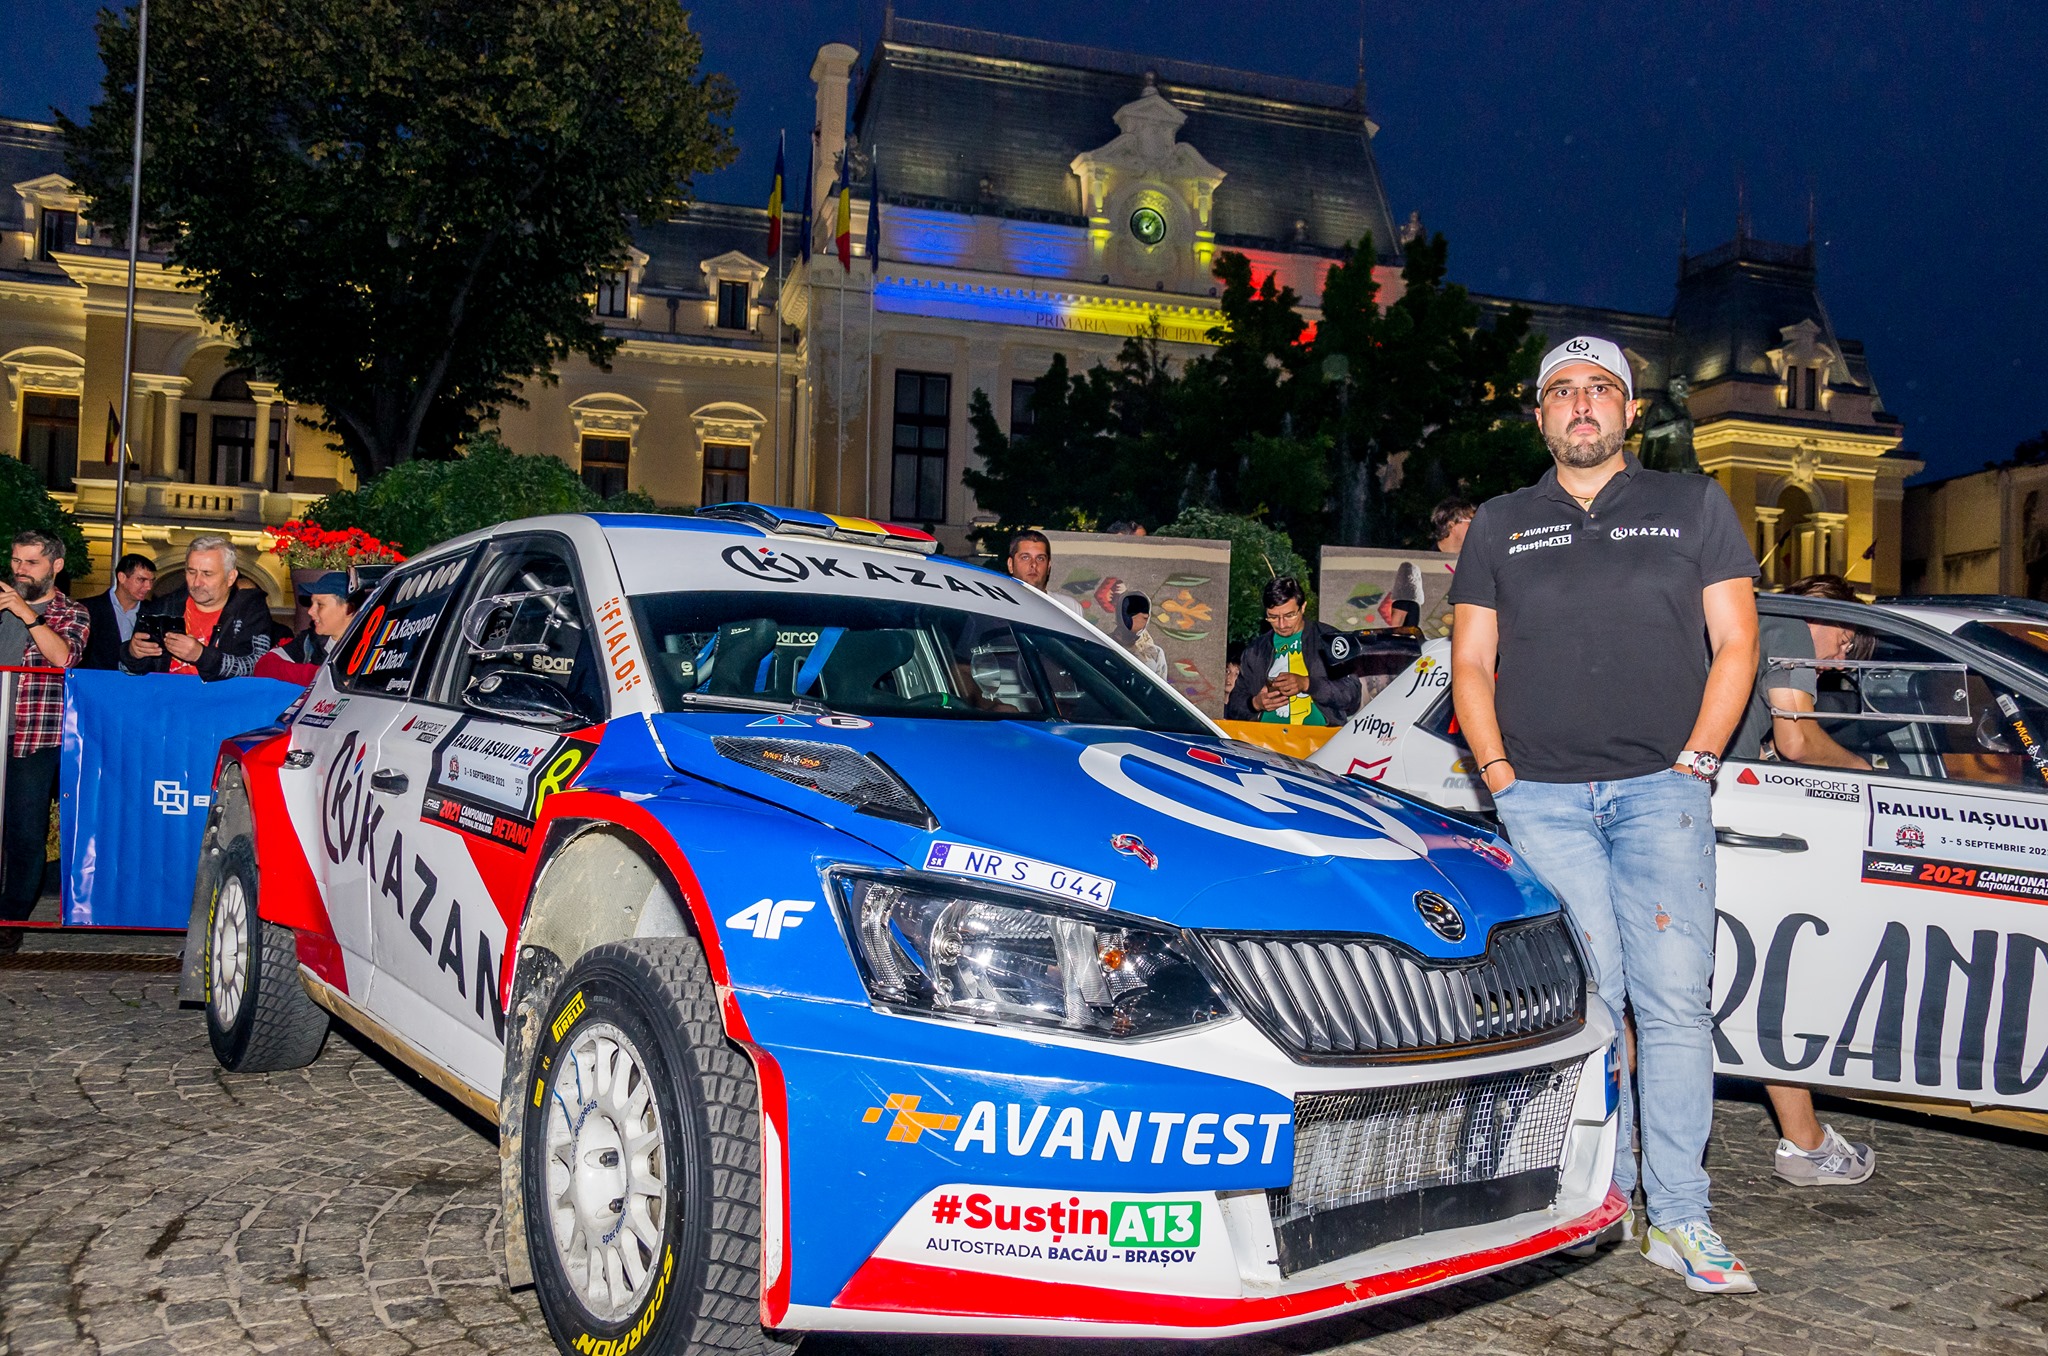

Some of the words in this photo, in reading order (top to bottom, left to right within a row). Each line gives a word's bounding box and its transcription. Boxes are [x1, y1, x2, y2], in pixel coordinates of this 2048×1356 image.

[1523, 524, 1572, 538] AVANTEST
[1629, 528, 1680, 538] KAZAN
[806, 556, 1021, 606] KAZAN
[346, 605, 386, 675] 8
[451, 733, 483, 754] RALIUL
[2013, 720, 2033, 747] PAVEL
[1765, 774, 1848, 791] LOOKSPORT
[1851, 783, 1859, 793] 3
[1814, 790, 1859, 802] MOTORS
[439, 799, 462, 822] 2021
[1877, 801, 1954, 821] RALIUL
[492, 817, 532, 848] BETANO
[1957, 838, 1962, 846] 5
[1965, 840, 2026, 853] SEPTEMBRIE
[930, 857, 944, 866] SK
[965, 851, 1003, 876] NR
[1011, 861, 1029, 881] S
[1050, 871, 1103, 901] 044
[1918, 863, 1977, 886] 2021
[2020, 886, 2033, 894] DE
[357, 790, 505, 1047] KAZAN
[725, 898, 816, 940] 4F
[551, 990, 587, 1043] PIRELLI
[953, 1100, 1292, 1166] AVANTEST
[926, 1237, 1043, 1260] AUTOSTRADA
[1047, 1244, 1108, 1263] BACĂU
[1124, 1249, 1196, 1269] BRAȘOV
[576, 1244, 674, 1356] SCORPION
